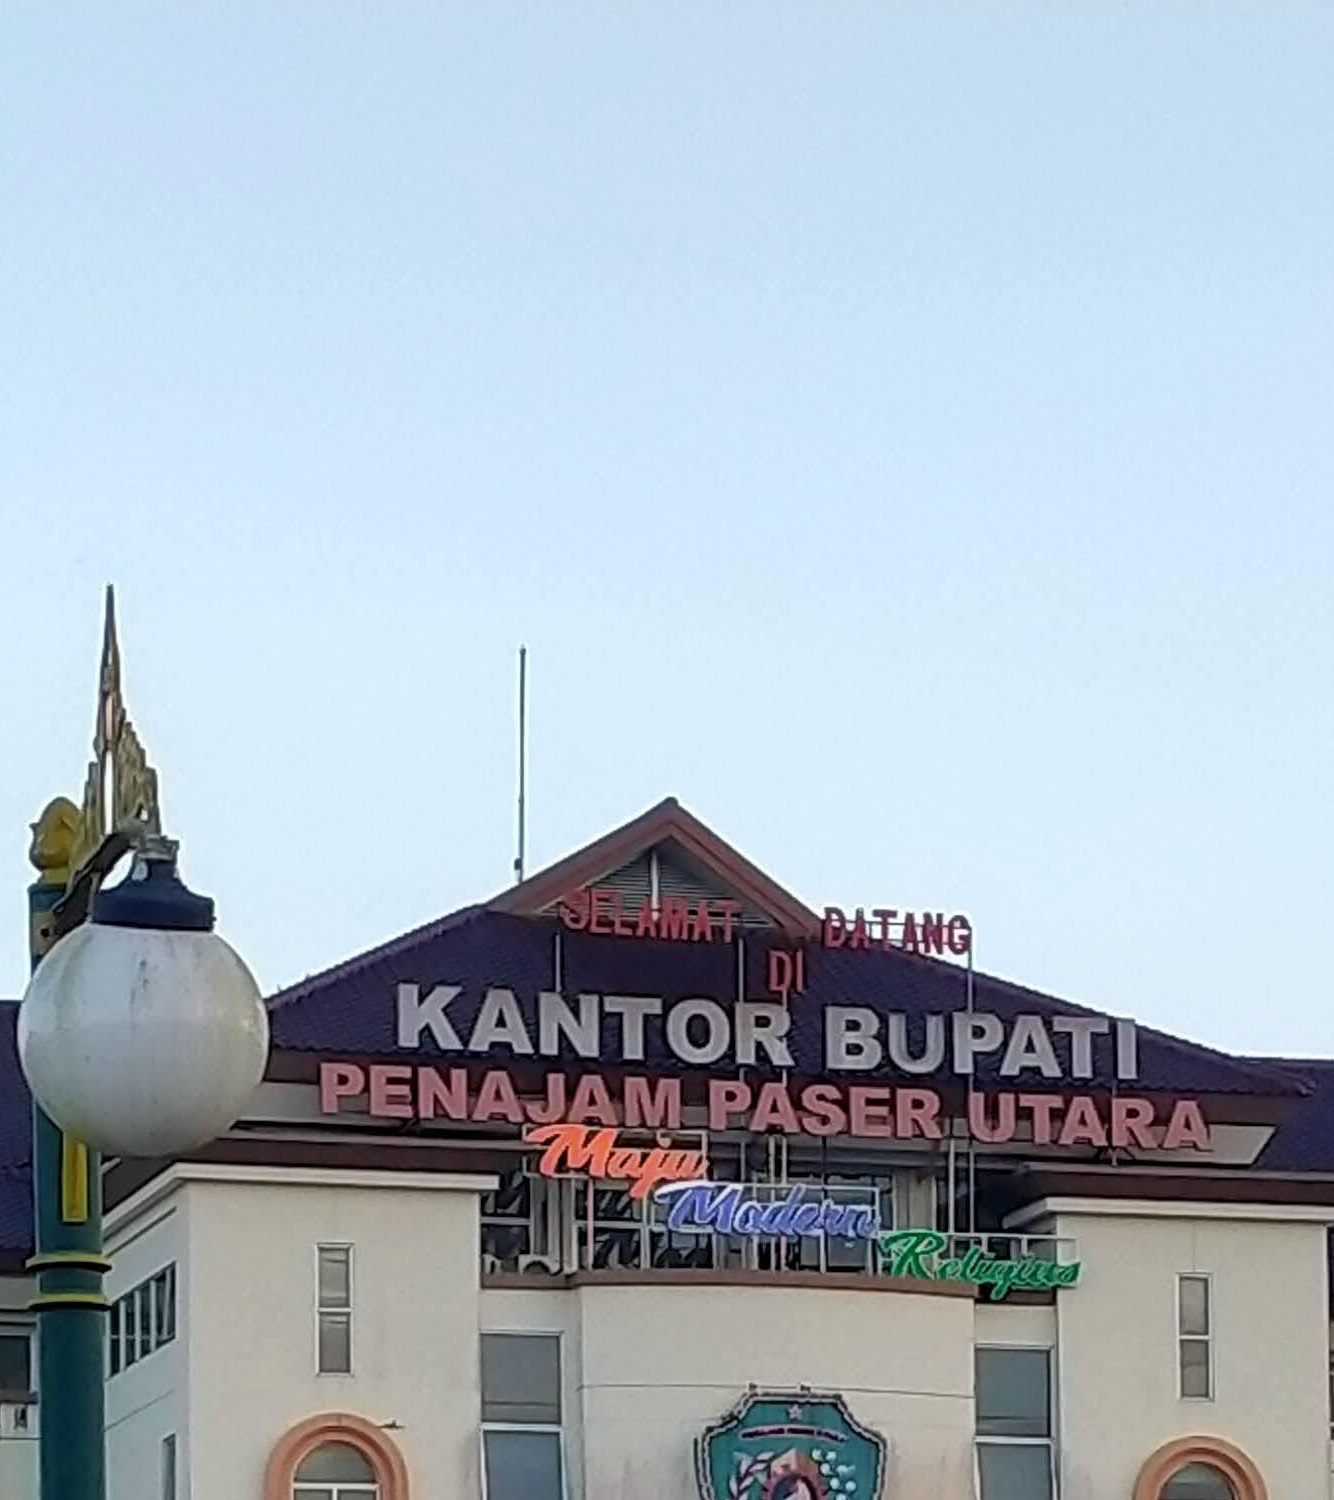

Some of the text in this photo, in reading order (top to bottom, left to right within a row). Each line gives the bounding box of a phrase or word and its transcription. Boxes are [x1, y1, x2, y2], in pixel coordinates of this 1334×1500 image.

[560, 891, 971, 956] SELAMAT DATANG
[769, 948, 804, 992] DI
[396, 983, 1138, 1080] KANTOR BUPATI
[319, 1061, 1211, 1151] PENAJAM PASER UTARA
[524, 1123, 708, 1199] Maju
[654, 1181, 880, 1238] Modern
[882, 1228, 1081, 1300] Religius
